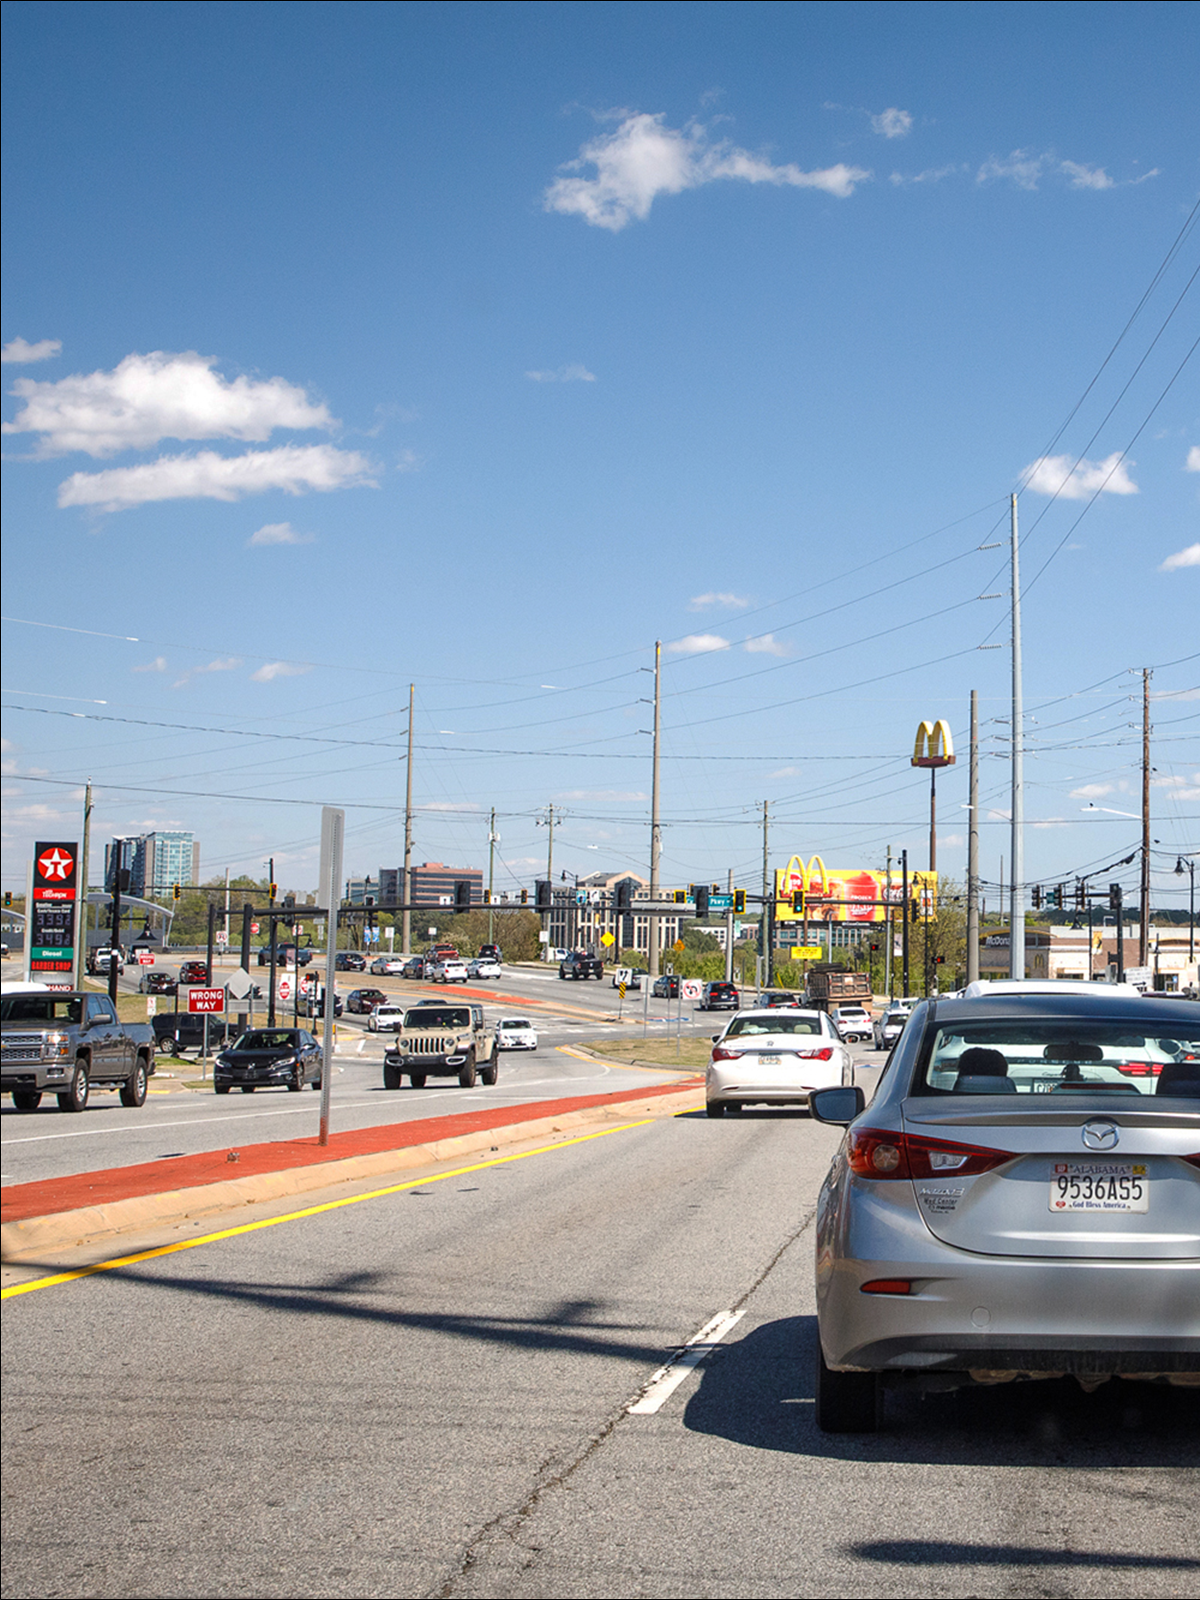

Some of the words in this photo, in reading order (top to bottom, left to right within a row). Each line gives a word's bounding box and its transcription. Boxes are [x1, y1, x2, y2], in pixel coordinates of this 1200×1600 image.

[190, 991, 223, 1000] WRONG
[196, 1001, 215, 1010] WAY
[1073, 1165, 1126, 1174] ALABAMA
[1103, 1201, 1126, 1209] America
